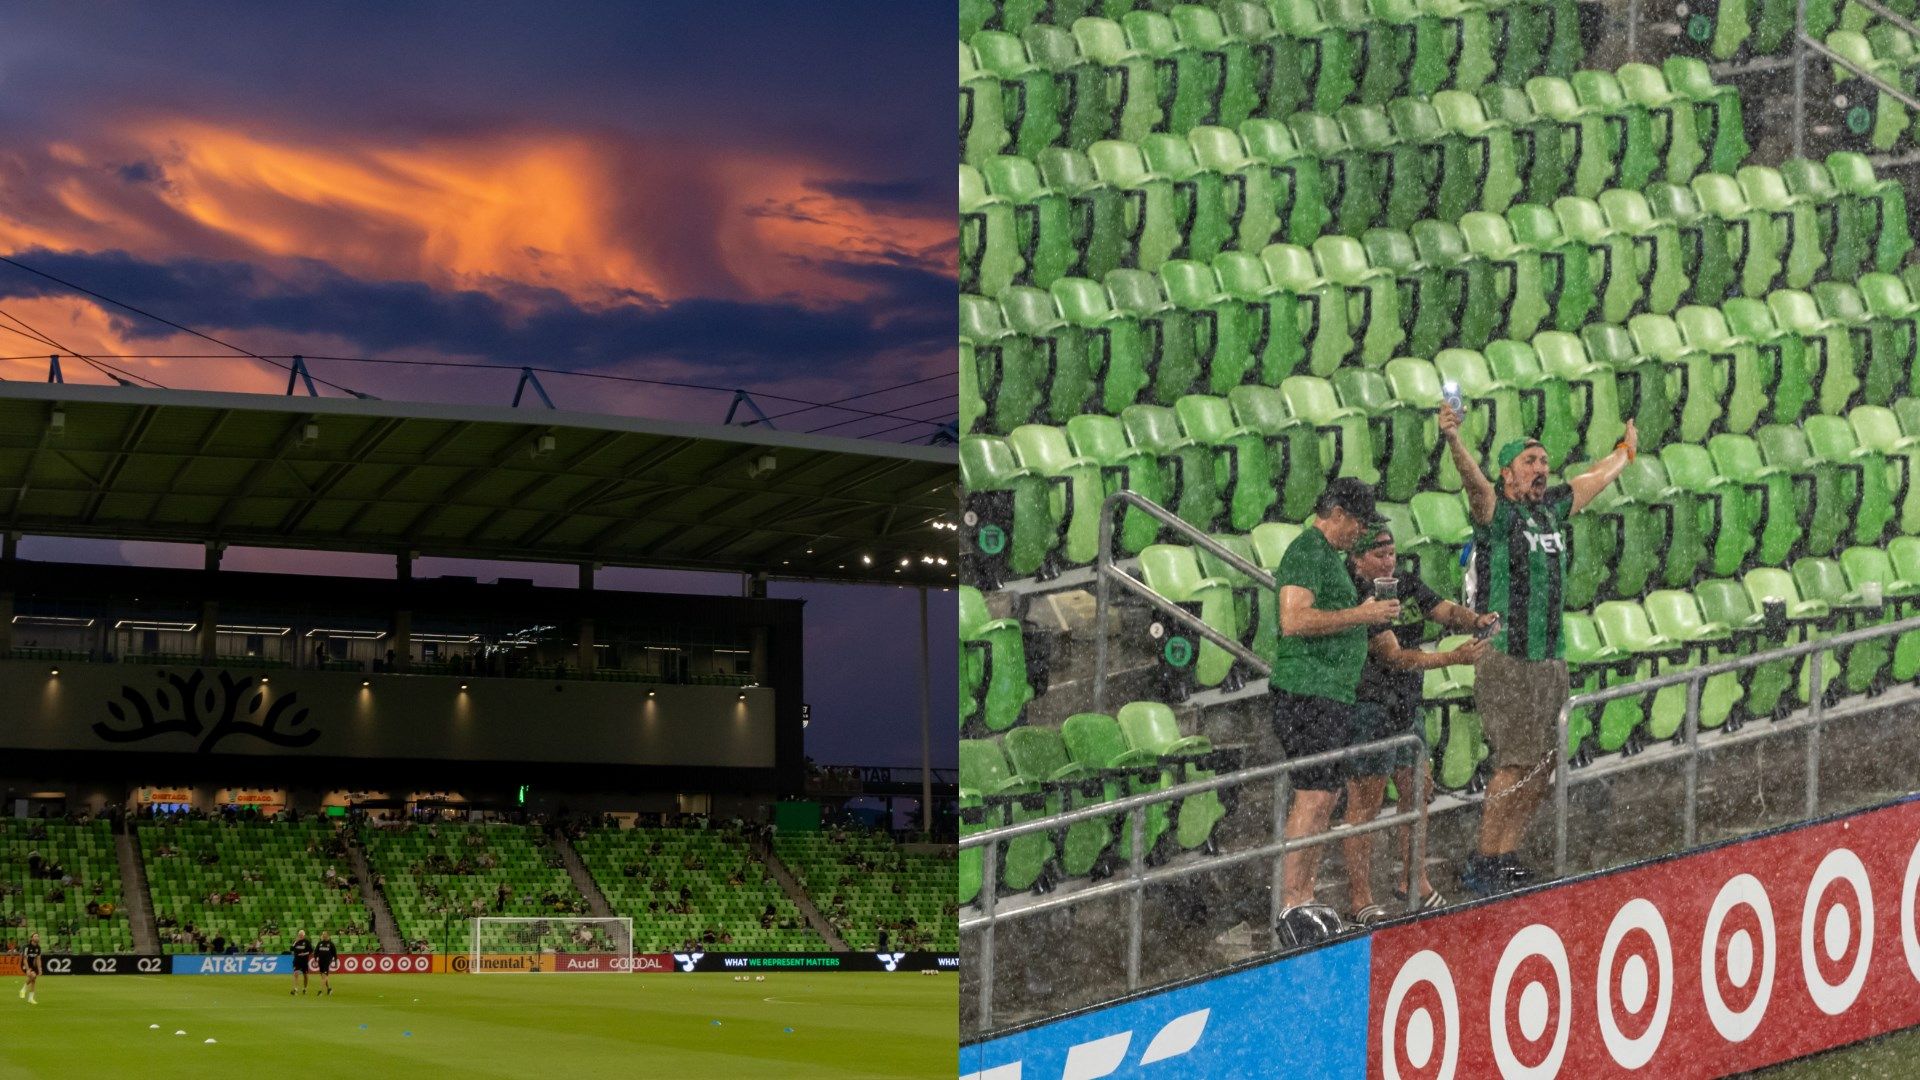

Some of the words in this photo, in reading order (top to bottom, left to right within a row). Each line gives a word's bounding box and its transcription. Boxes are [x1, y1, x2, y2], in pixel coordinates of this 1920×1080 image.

[46, 958, 72, 973] Q2
[92, 958, 117, 973] Q2
[137, 958, 162, 973] Q2
[200, 956, 247, 973] AT&T
[247, 956, 278, 973] 5G
[567, 958, 599, 969] Audi
[724, 958, 748, 967] WHAT
[749, 958, 762, 967] WE
[762, 958, 805, 967] REPRESENT
[806, 958, 840, 967] MATTERS
[938, 958, 959, 966] WHAT
